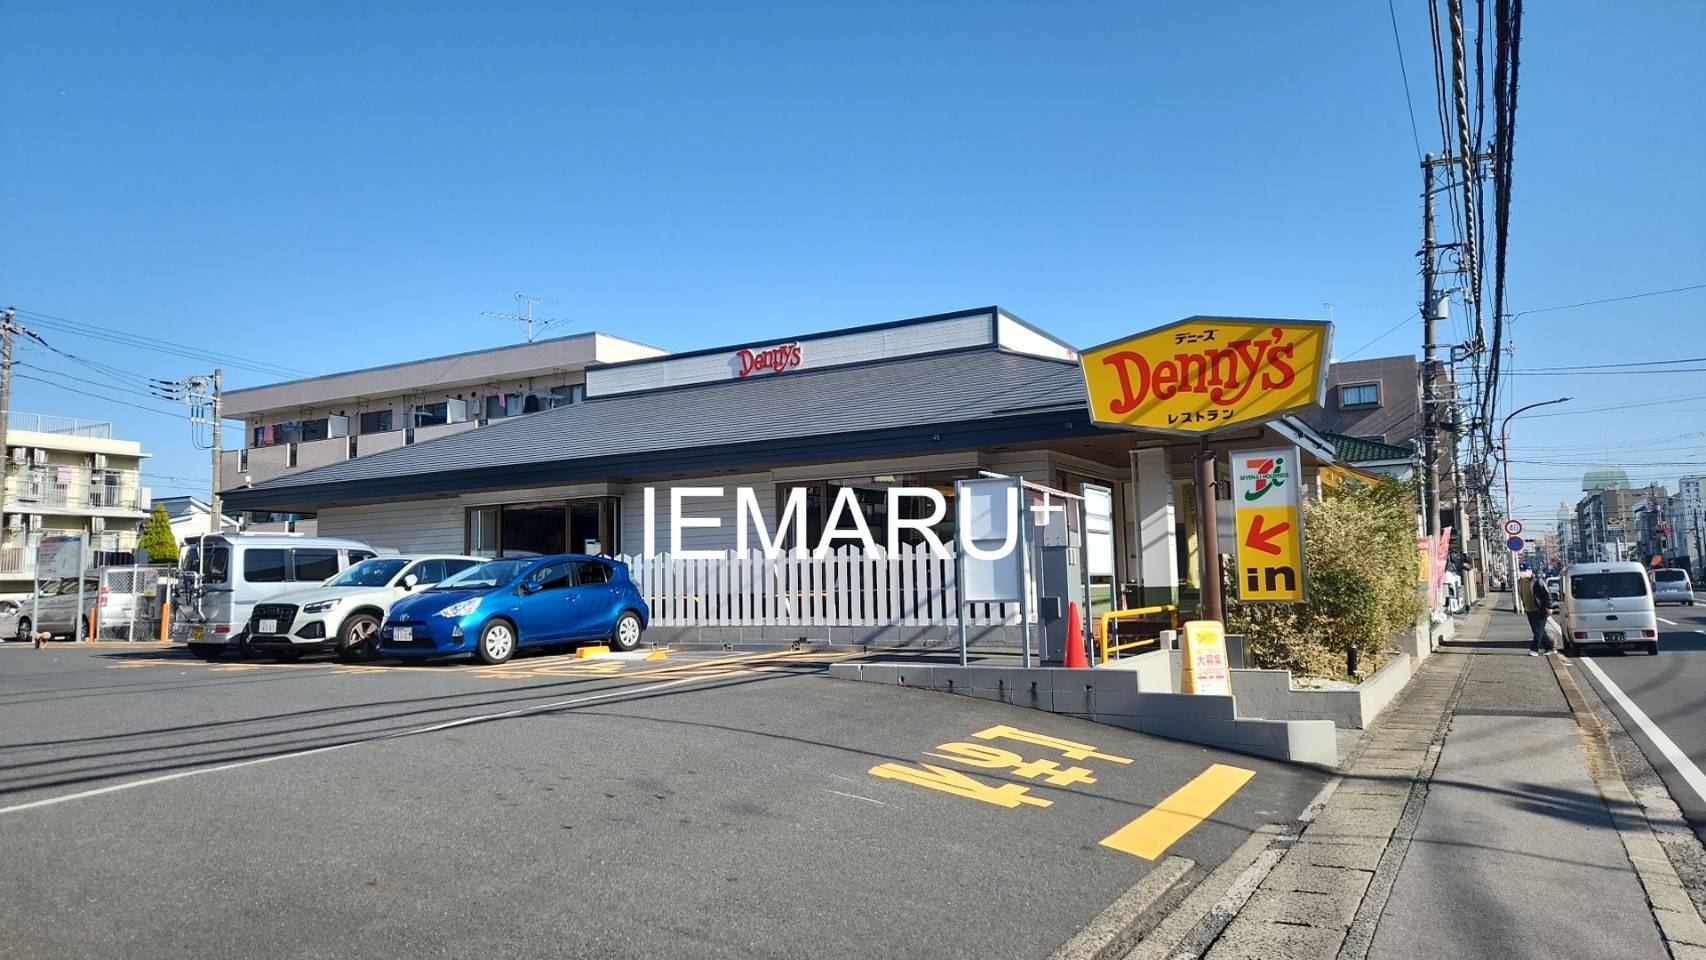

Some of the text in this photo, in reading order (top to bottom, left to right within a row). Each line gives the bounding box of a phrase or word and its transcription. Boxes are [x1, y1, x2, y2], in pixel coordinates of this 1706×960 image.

[1175, 329, 1219, 345] デニーズ
[736, 341, 801, 377] Denny's
[1102, 327, 1296, 414] Denny's
[1168, 409, 1234, 425] レストラン
[1247, 566, 1296, 592] in
